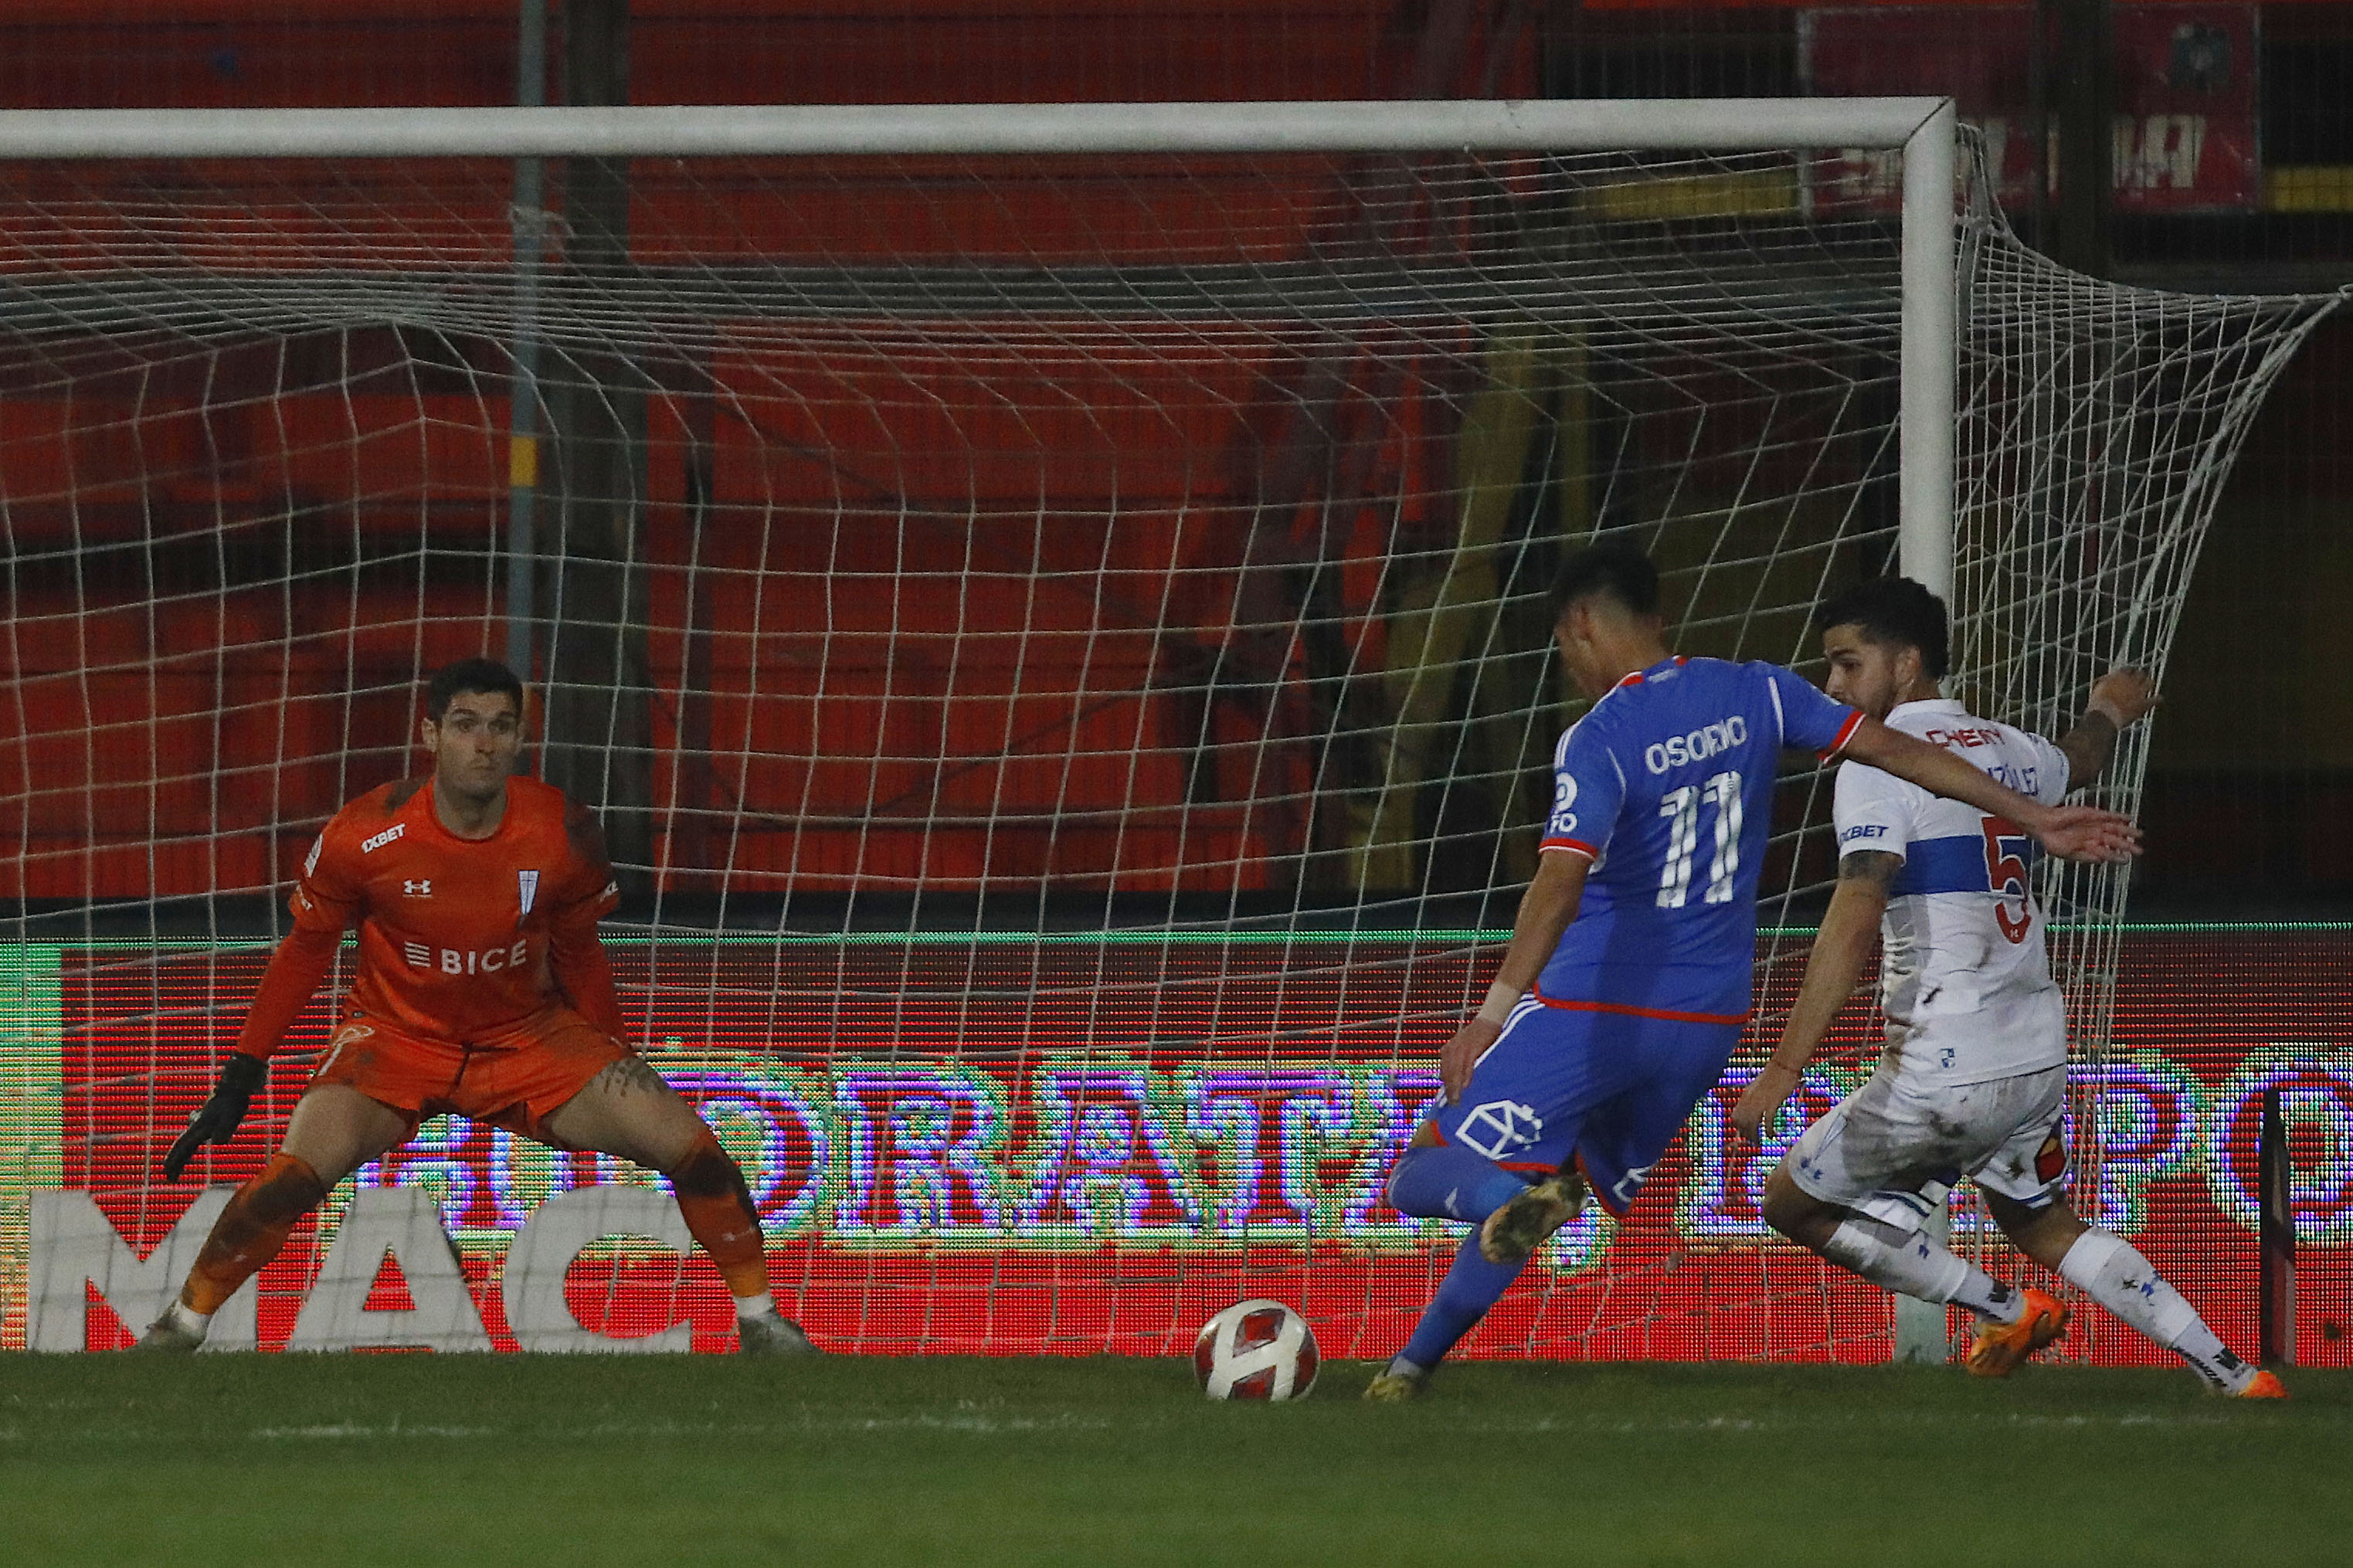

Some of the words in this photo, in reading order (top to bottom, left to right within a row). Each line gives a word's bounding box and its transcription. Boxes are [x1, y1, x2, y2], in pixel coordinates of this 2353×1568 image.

[361, 823, 406, 854] 1XBET
[1655, 770, 1743, 908] 11
[1839, 824, 1890, 847] XBET
[1981, 815, 2032, 945] 5
[440, 938, 528, 975] BICE
[26, 1188, 693, 1353] MAC
